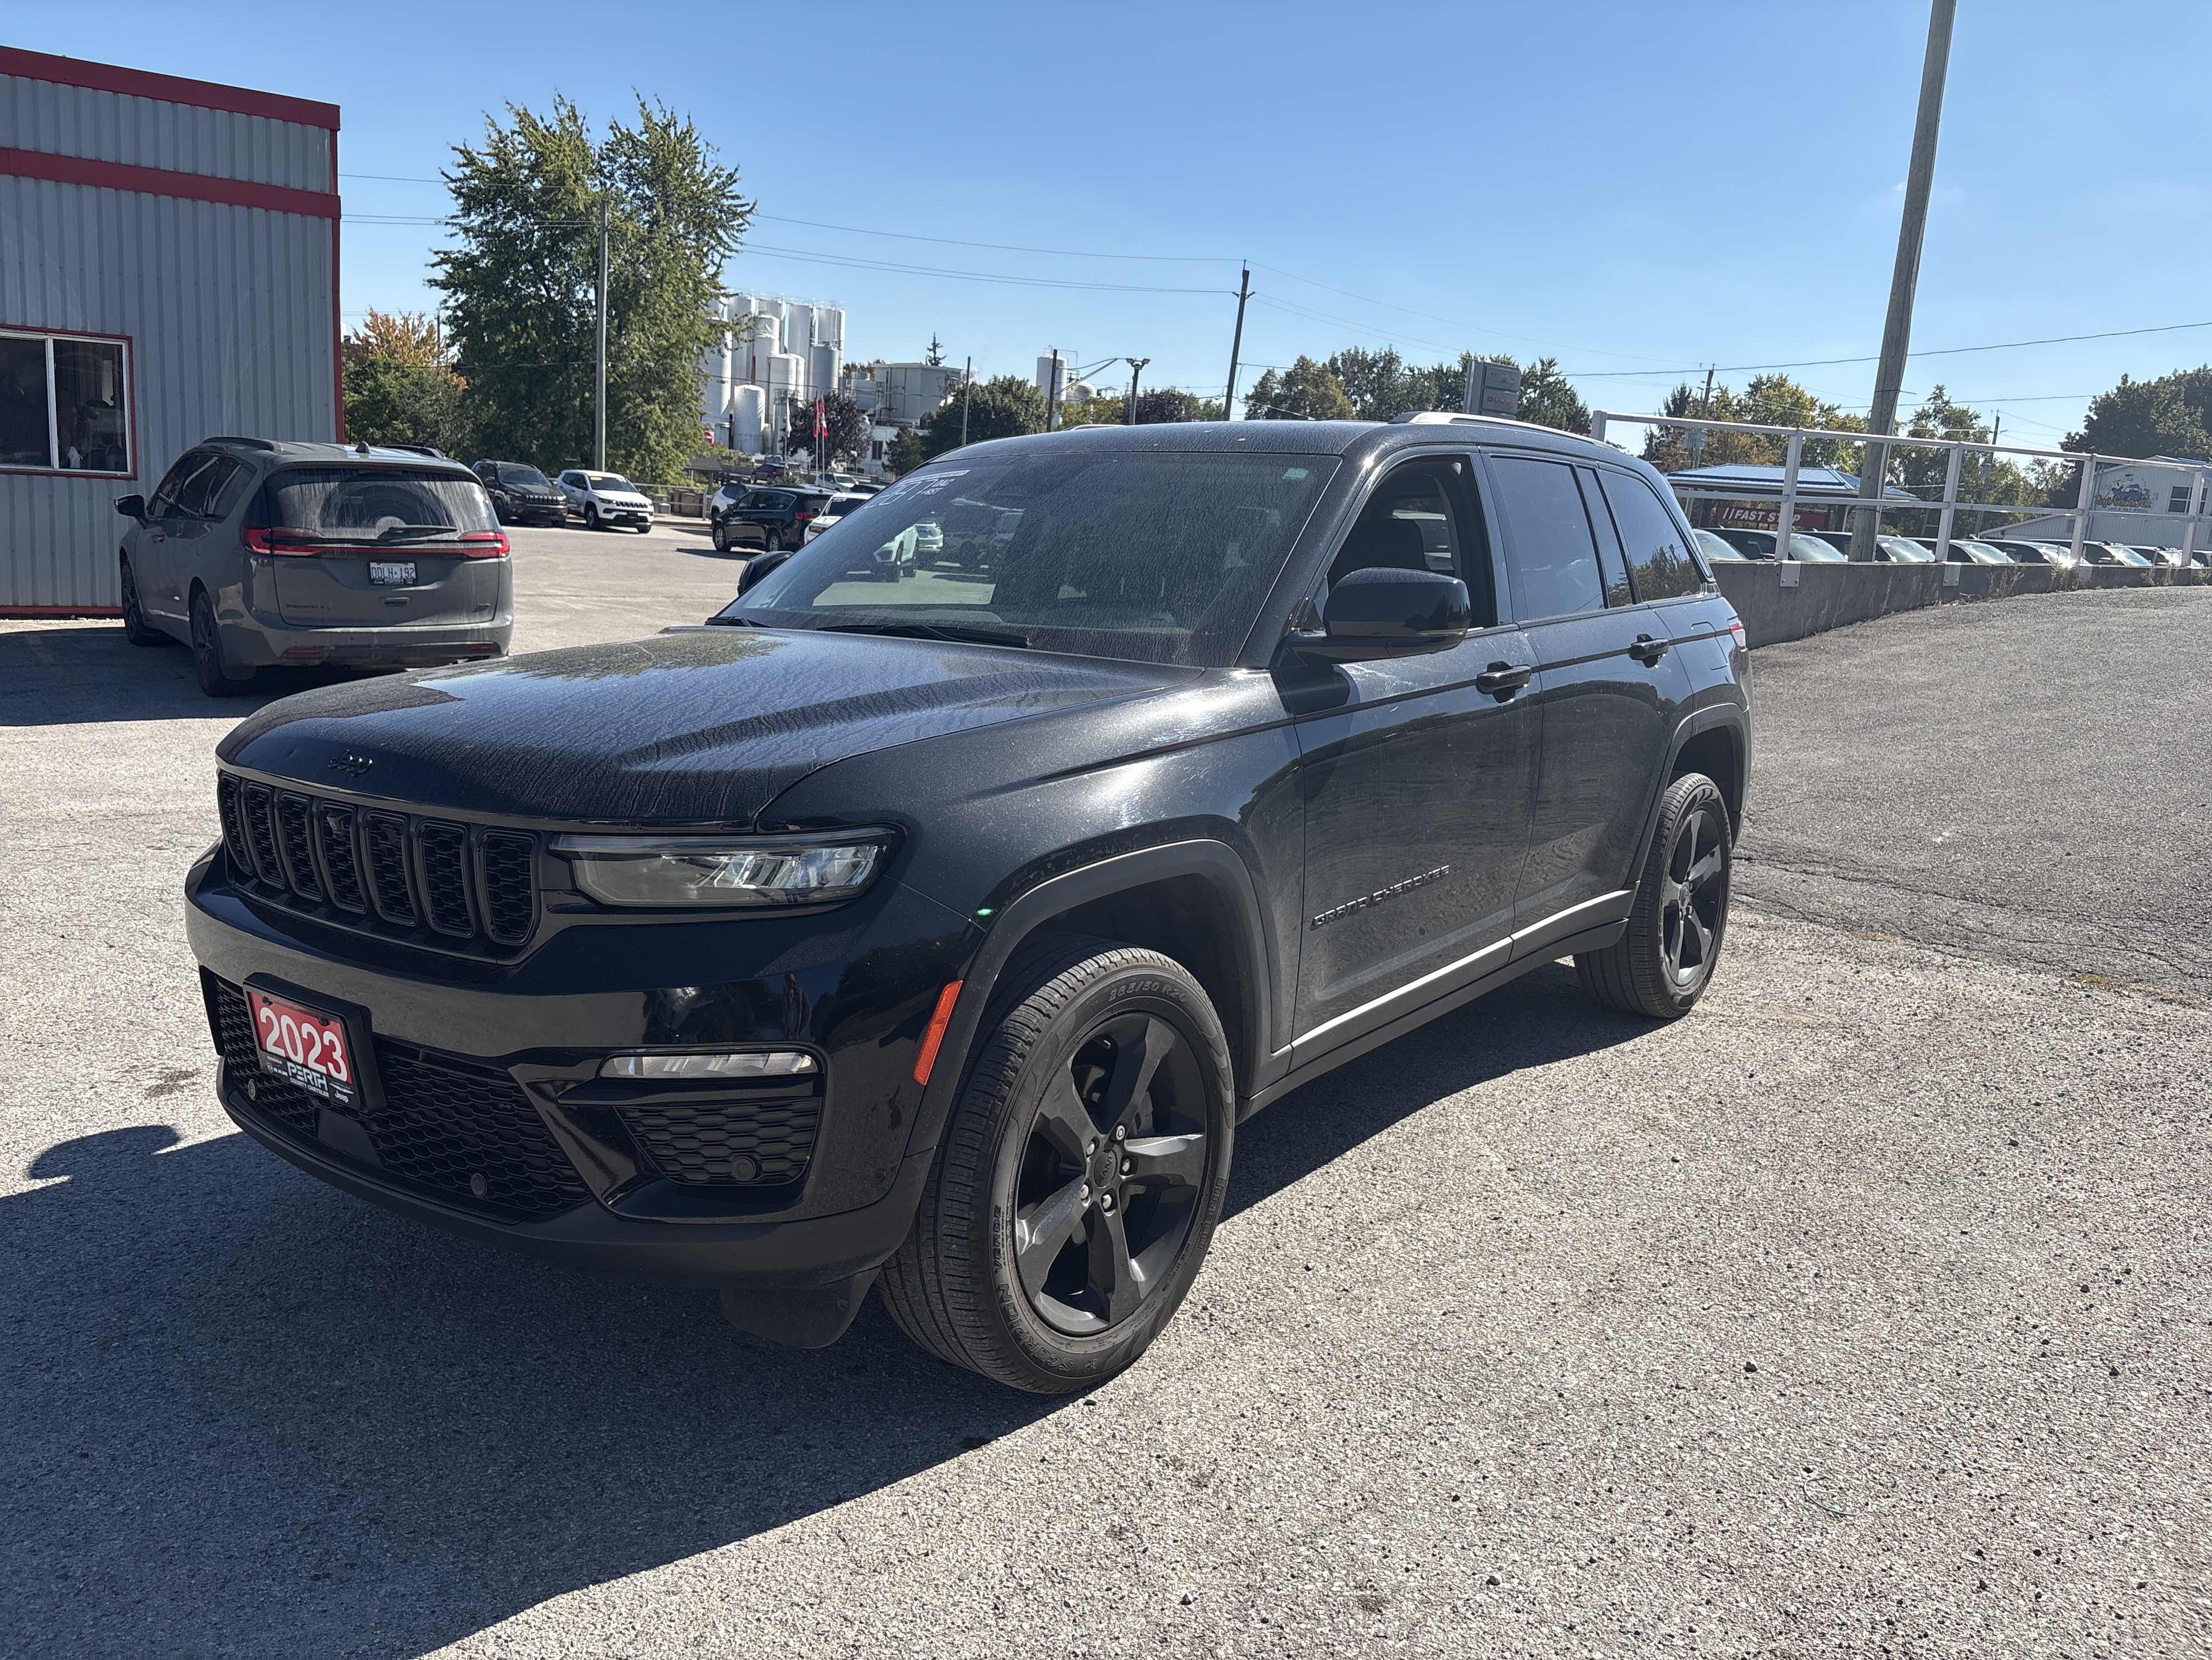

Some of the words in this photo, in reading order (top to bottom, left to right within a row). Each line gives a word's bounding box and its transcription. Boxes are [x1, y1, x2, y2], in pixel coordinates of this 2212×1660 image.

[1734, 509, 1766, 521] FAST
[1310, 896, 1368, 930] GRAND
[1369, 865, 1450, 905] CHEROKEE
[260, 1007, 347, 1081] 2023
[273, 1067, 288, 1076] RAM
[286, 1061, 328, 1091] PERTH
[290, 1078, 307, 1089] COUNTY
[307, 1085, 330, 1098] CHRYSLER
[334, 1091, 349, 1103] Jeep
[998, 1282, 1075, 1371] SCORPION
